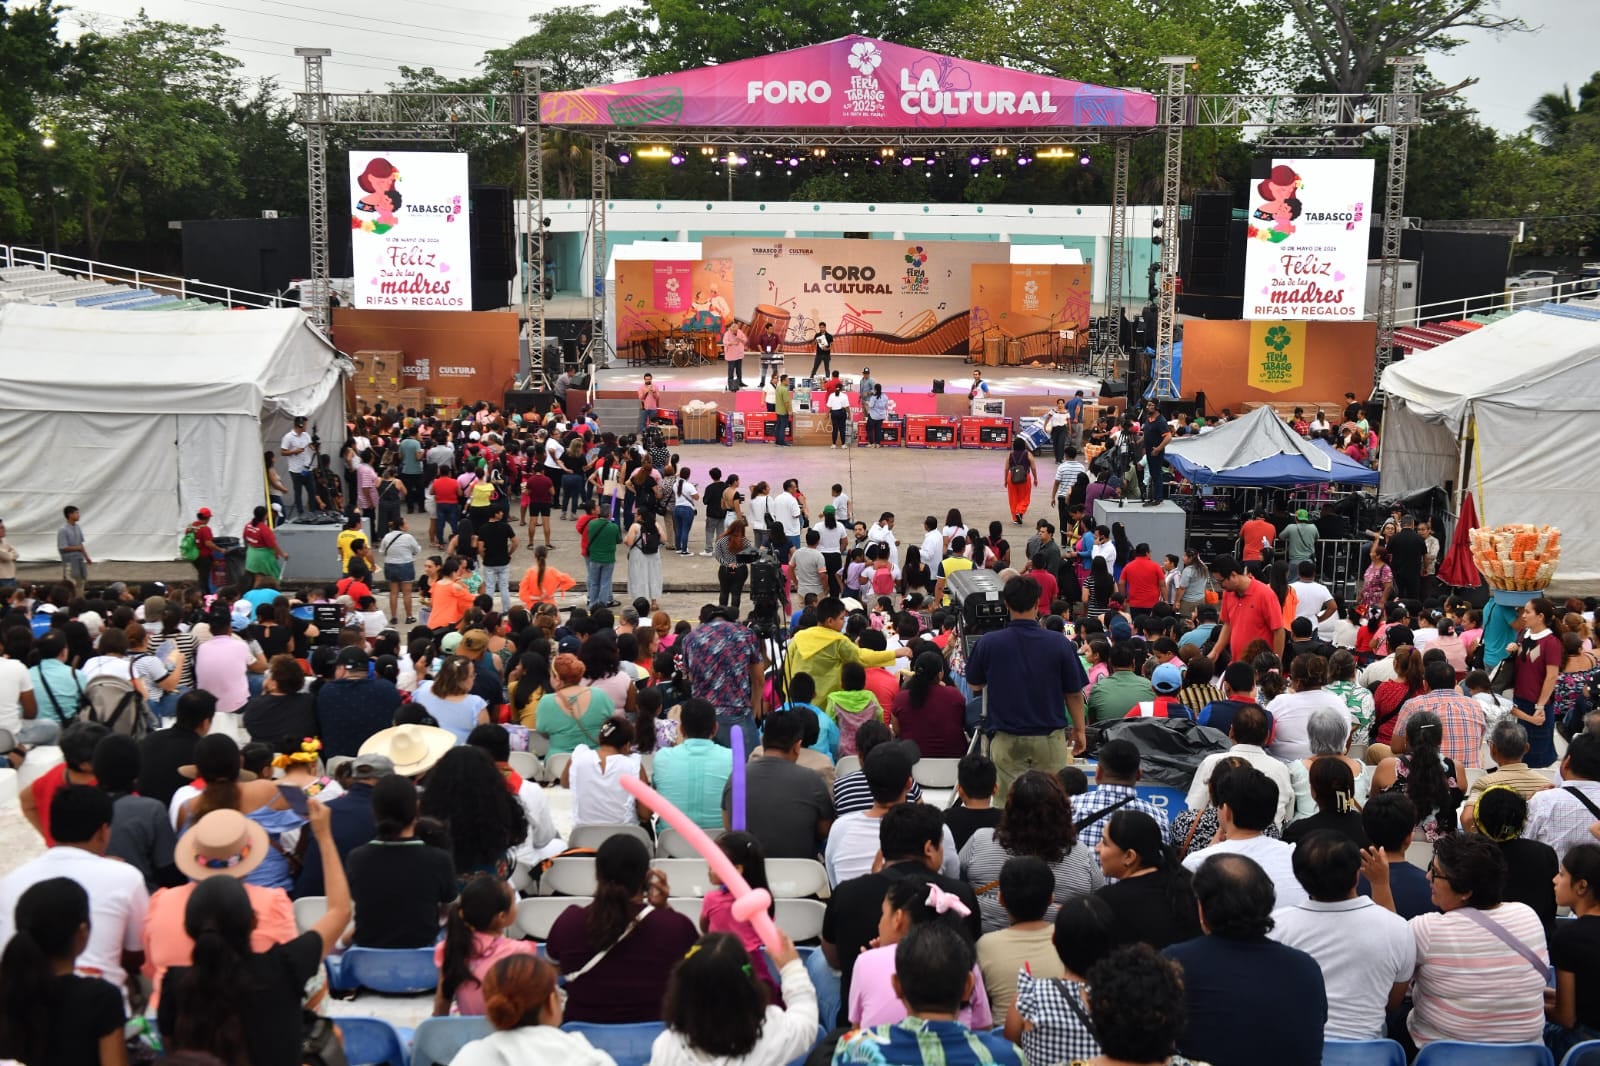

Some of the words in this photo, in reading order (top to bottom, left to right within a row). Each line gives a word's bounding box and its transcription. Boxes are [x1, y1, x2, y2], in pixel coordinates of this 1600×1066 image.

[851, 75, 879, 90] FERIA
[901, 68, 939, 92] LA
[747, 80, 831, 104] FORO
[852, 100, 876, 112] 2025
[901, 90, 1057, 114] CULTURAL
[406, 204, 452, 214] TABASCO
[1305, 212, 1353, 221] TABASCO
[386, 245, 436, 267] Feliz
[1280, 254, 1331, 276] Feliz
[821, 265, 876, 281] FORO
[381, 273, 451, 295] madres
[803, 283, 825, 293] LA
[828, 283, 893, 295] CULTURAL
[1270, 281, 1345, 304] madres
[366, 296, 398, 305] RIFAS
[402, 297, 409, 305] Y
[411, 297, 464, 306] REGALOS
[1254, 306, 1288, 315] RIFAS
[1291, 306, 1298, 315] Y
[1301, 306, 1356, 315] REGALOS
[1266, 352, 1288, 363] FERIA
[439, 366, 477, 375] CULTURA
[1267, 370, 1286, 380] 2025
